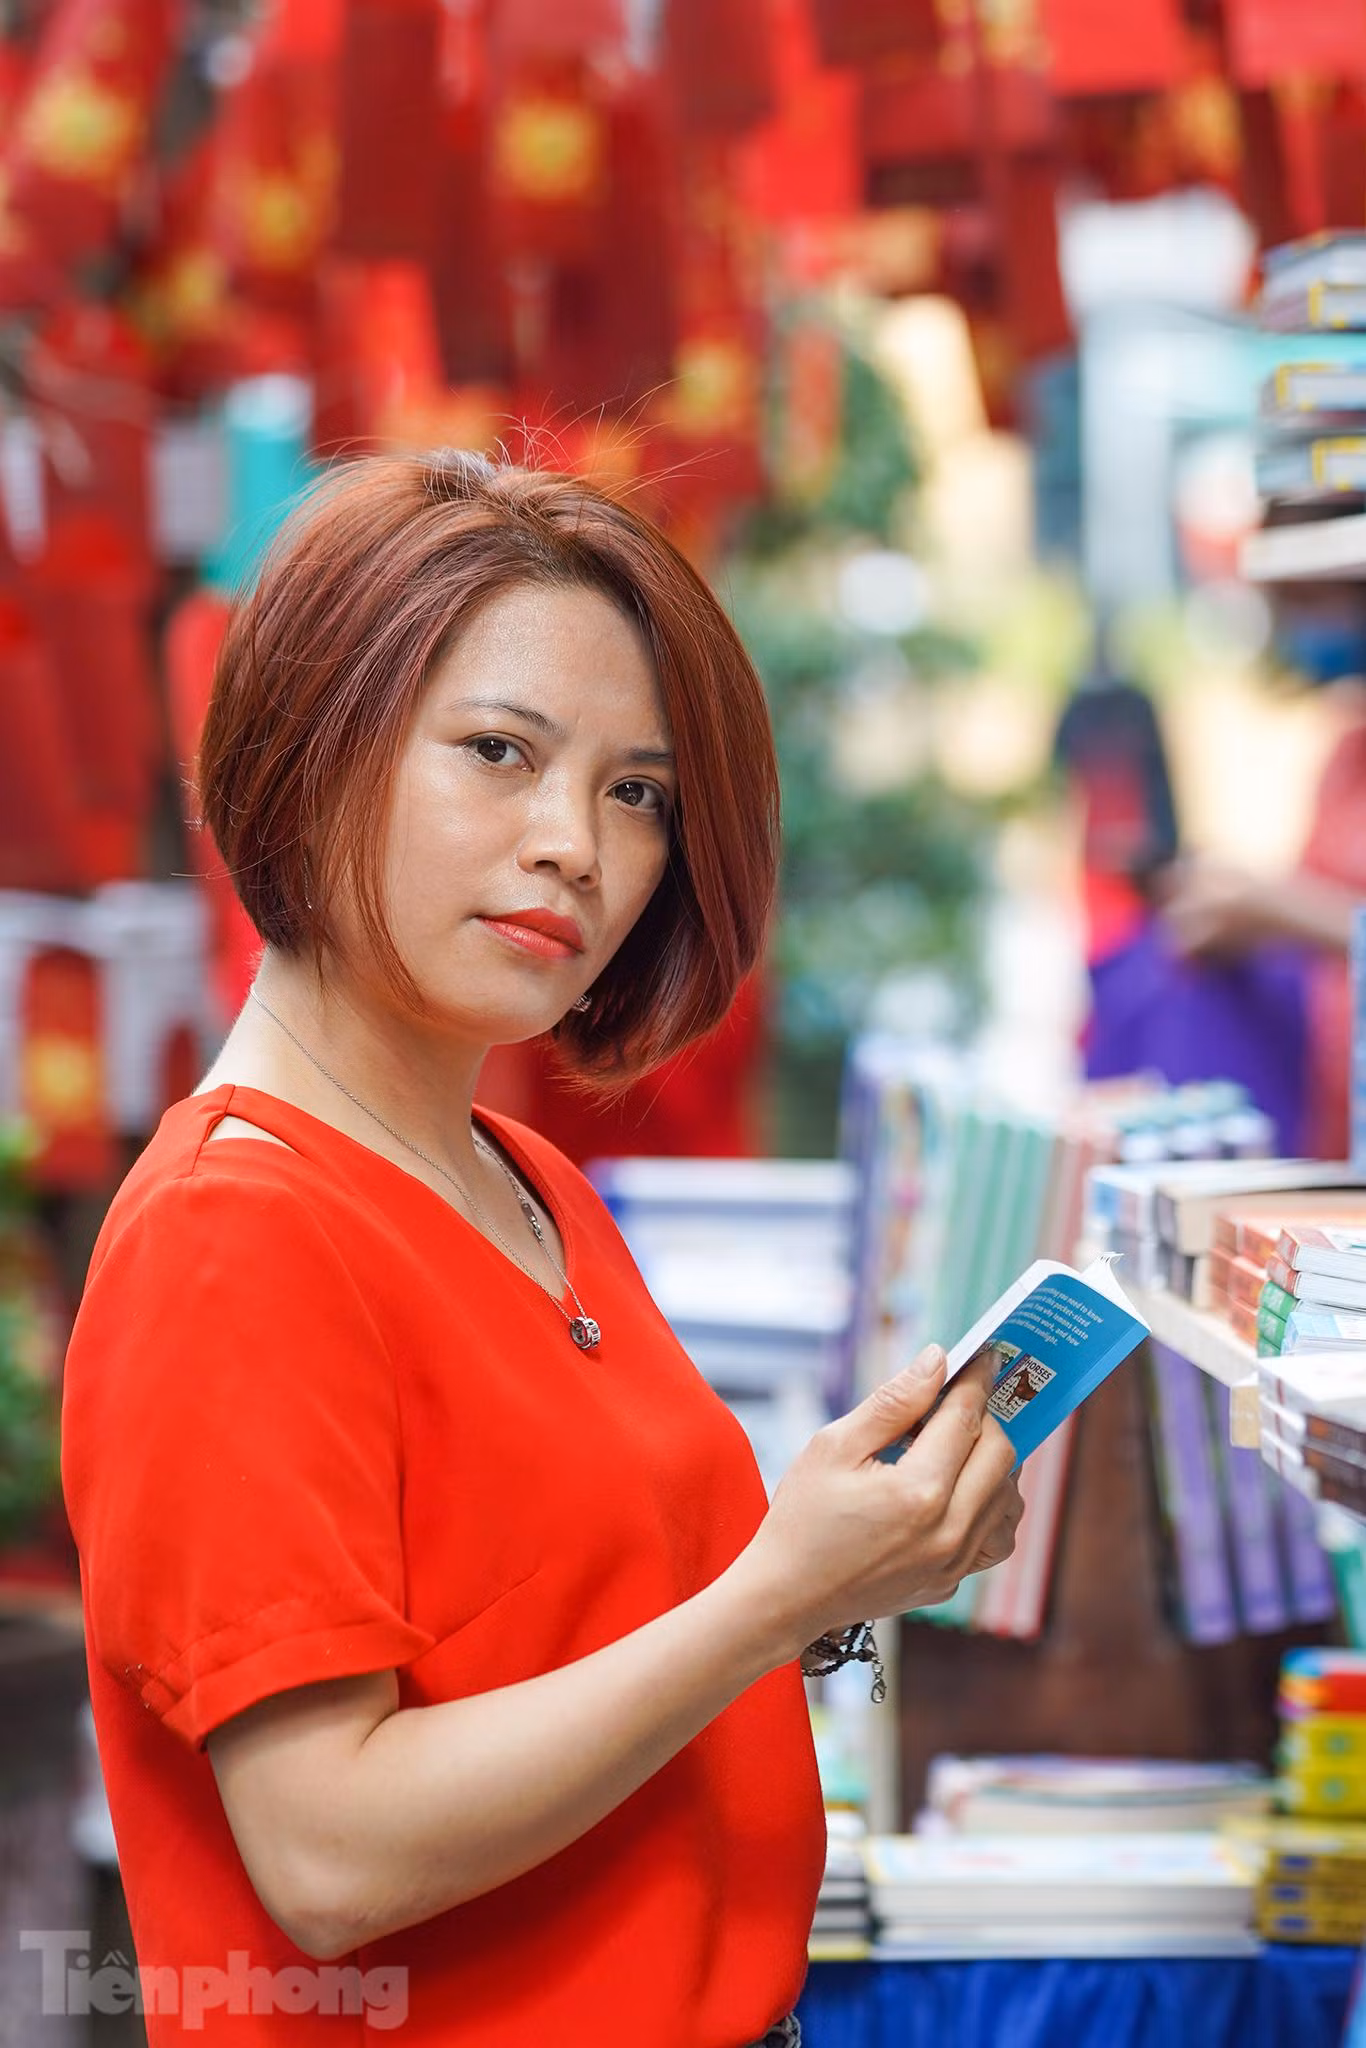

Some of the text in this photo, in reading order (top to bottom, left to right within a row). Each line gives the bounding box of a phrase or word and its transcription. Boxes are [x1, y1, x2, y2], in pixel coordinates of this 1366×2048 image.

[1053, 1302, 1091, 1328] pocket-sized
[1087, 1309, 1104, 1323] know
[1053, 1313, 1073, 1329] lemons
[1072, 1326, 1089, 1341] taste
[1055, 1327, 1069, 1339] and
[1066, 1333, 1080, 1346] how
[1025, 1359, 1053, 1381] HORSES
